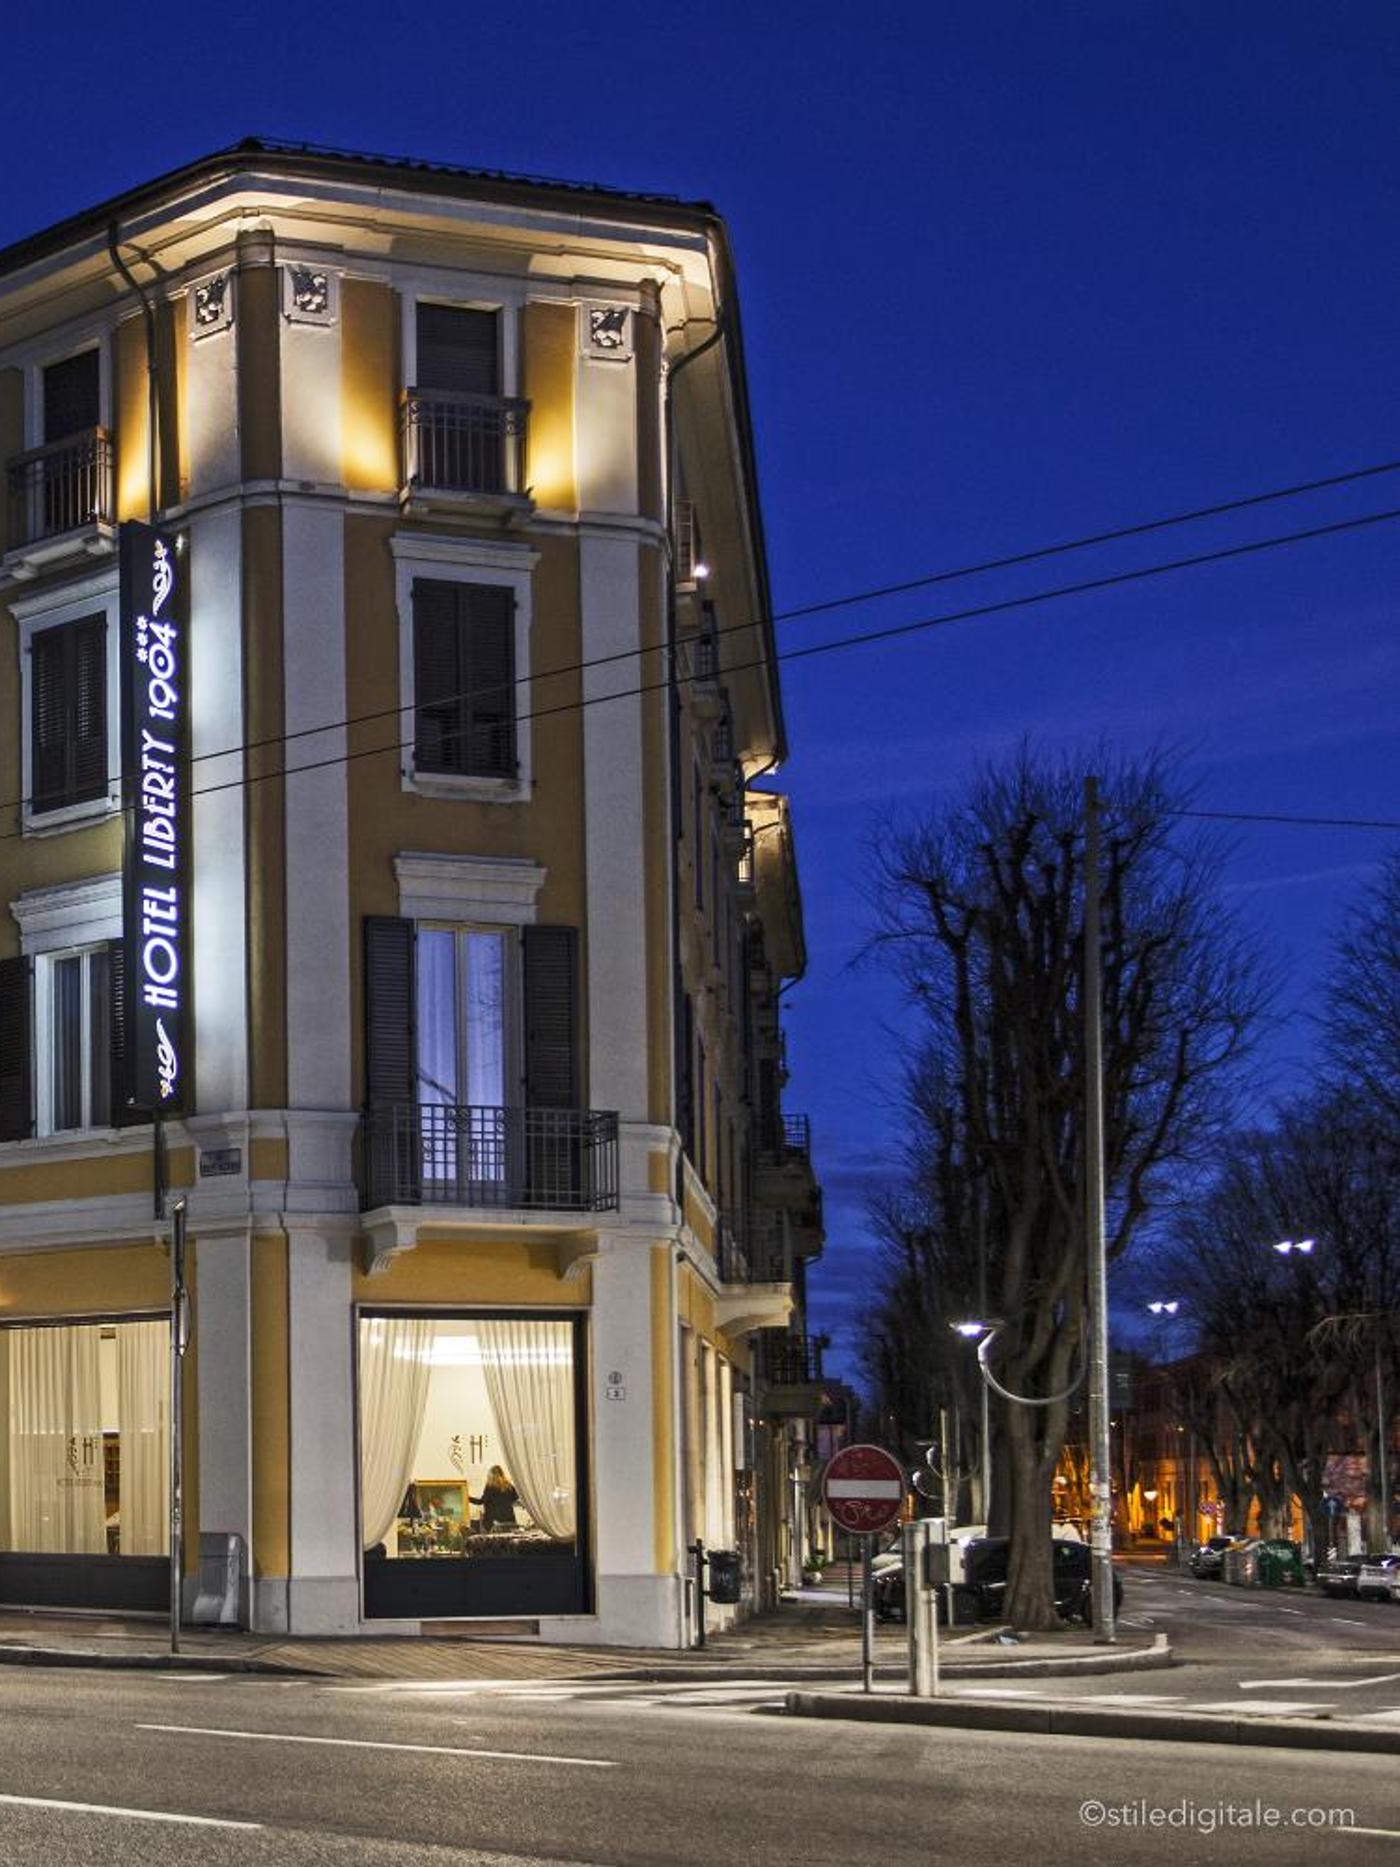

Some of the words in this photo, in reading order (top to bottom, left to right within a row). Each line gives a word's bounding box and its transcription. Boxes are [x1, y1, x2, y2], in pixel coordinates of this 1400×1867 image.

[148, 621, 177, 720] 1904
[141, 728, 176, 869] LIBERTY
[142, 887, 178, 1009] HOTEL
